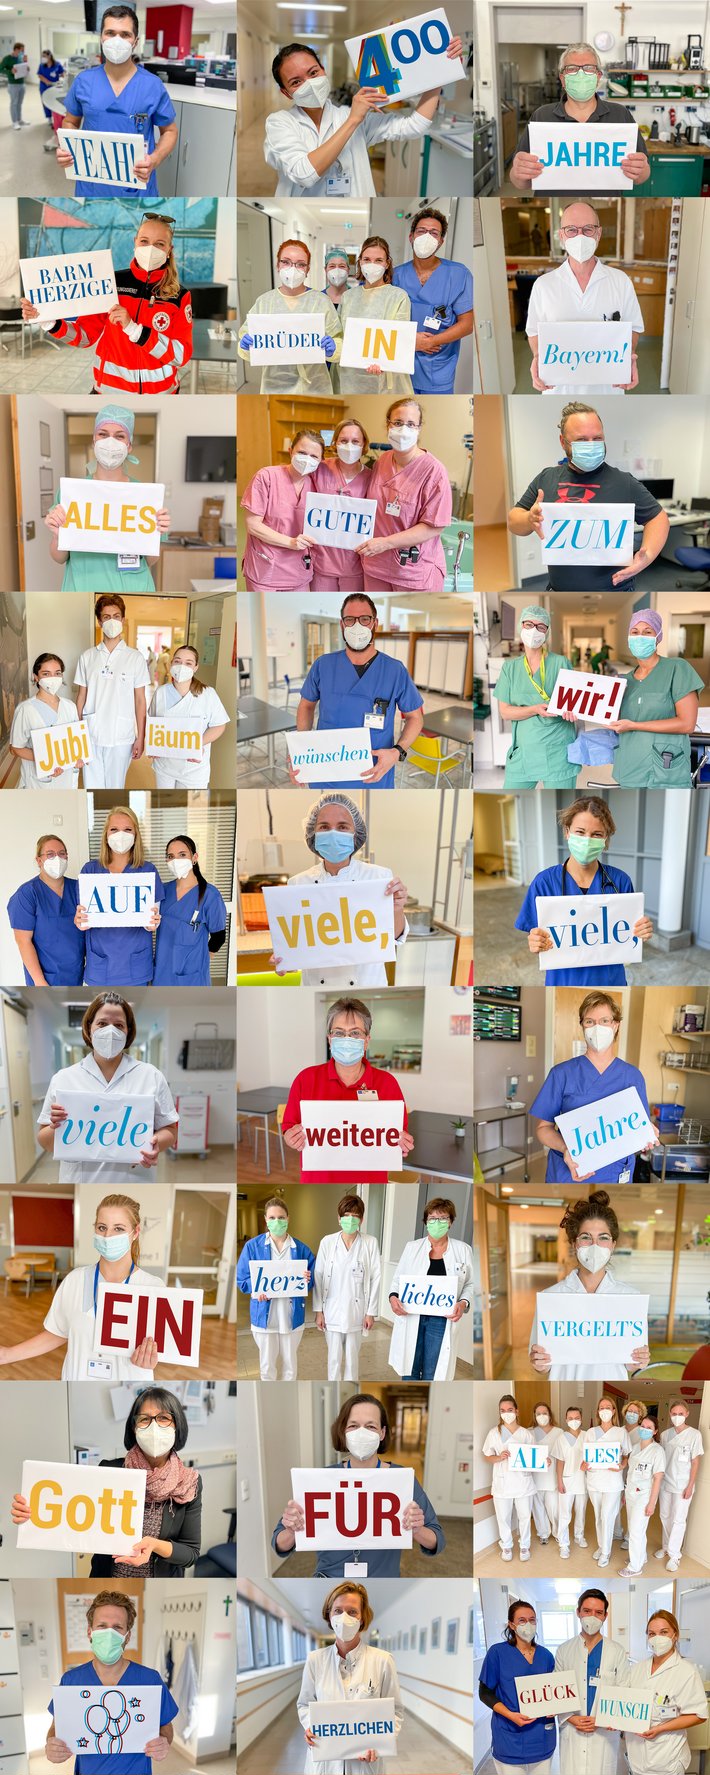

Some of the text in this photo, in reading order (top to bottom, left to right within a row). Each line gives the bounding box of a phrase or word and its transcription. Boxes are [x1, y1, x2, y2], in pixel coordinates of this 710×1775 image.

[356, 20, 450, 95] 400
[64, 137, 138, 184] YEAH!
[539, 141, 628, 168] JAHRE
[40, 263, 93, 285] BARM
[29, 279, 114, 305] HERZIGE
[252, 331, 321, 349] BRÜDER
[362, 328, 397, 360] IN
[543, 341, 629, 370] Bayern!
[63, 501, 156, 534] ALLES
[307, 509, 373, 535] GUTE
[545, 519, 629, 549] ZUM
[557, 681, 621, 718] wir!
[40, 724, 89, 771] Jubi
[149, 724, 200, 750] läum
[294, 743, 369, 765] wünschen
[87, 886, 152, 914] AUF
[276, 898, 388, 949] viele,
[550, 906, 638, 948] viele,
[62, 1104, 148, 1148] viele
[306, 1121, 399, 1146] weitere
[570, 1109, 648, 1157] Jahre.
[254, 1267, 304, 1292] herz
[401, 1283, 454, 1306] liches
[101, 1292, 194, 1356] EIN
[512, 1448, 546, 1469] AL
[585, 1448, 619, 1463] LES!
[29, 1480, 137, 1536] Gott
[305, 1481, 401, 1537] FÜR
[519, 1684, 577, 1705] GLÜCK
[600, 1698, 649, 1721] WUNSCH
[312, 1721, 394, 1737] HERZLICHEN
